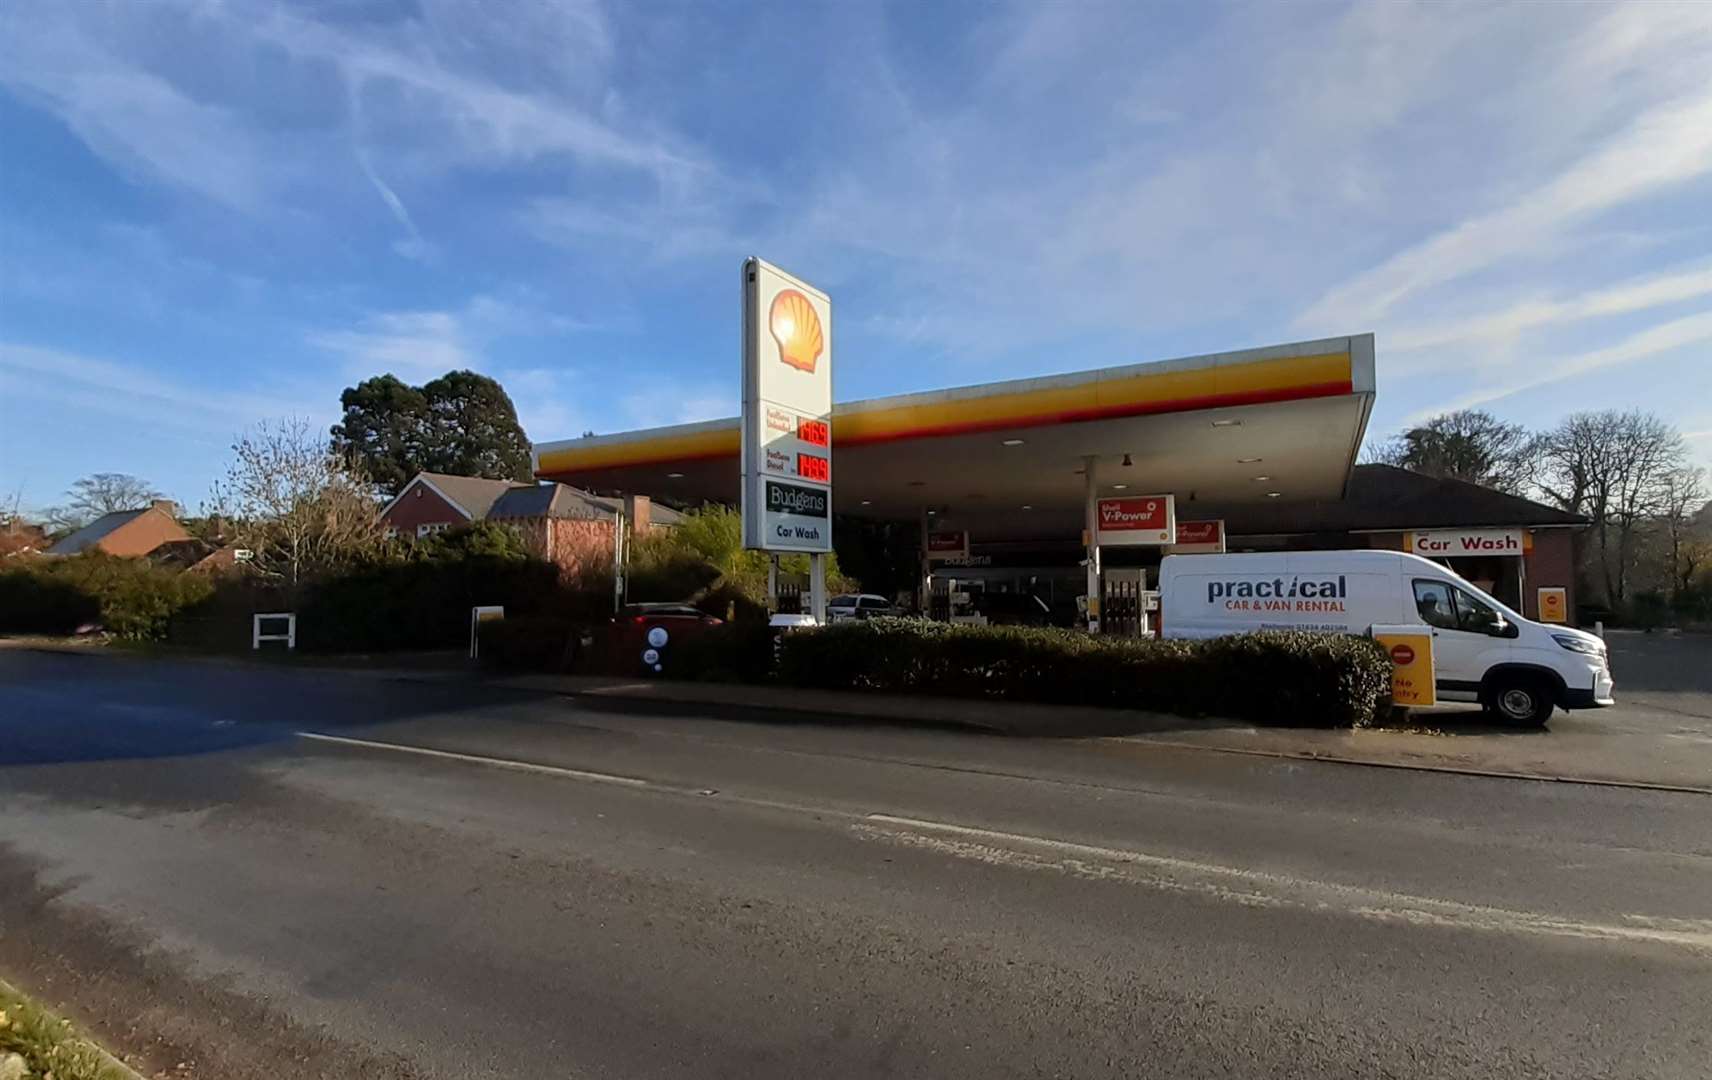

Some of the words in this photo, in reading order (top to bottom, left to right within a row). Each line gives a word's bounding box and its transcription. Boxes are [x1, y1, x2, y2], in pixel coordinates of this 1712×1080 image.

[771, 485, 825, 511] Budgens
[1103, 510, 1153, 522] V-Power
[776, 525, 793, 538] Car
[795, 526, 820, 540] Wash
[1417, 538, 1451, 551] Car
[1460, 535, 1518, 551] Wash
[1208, 575, 1346, 603] practical
[1225, 600, 1249, 610] CAR
[1253, 600, 1262, 610] &
[1264, 600, 1291, 611] VAN
[1296, 600, 1346, 612] RENTAL
[1395, 678, 1412, 688] No
[1395, 690, 1419, 700] ntry
